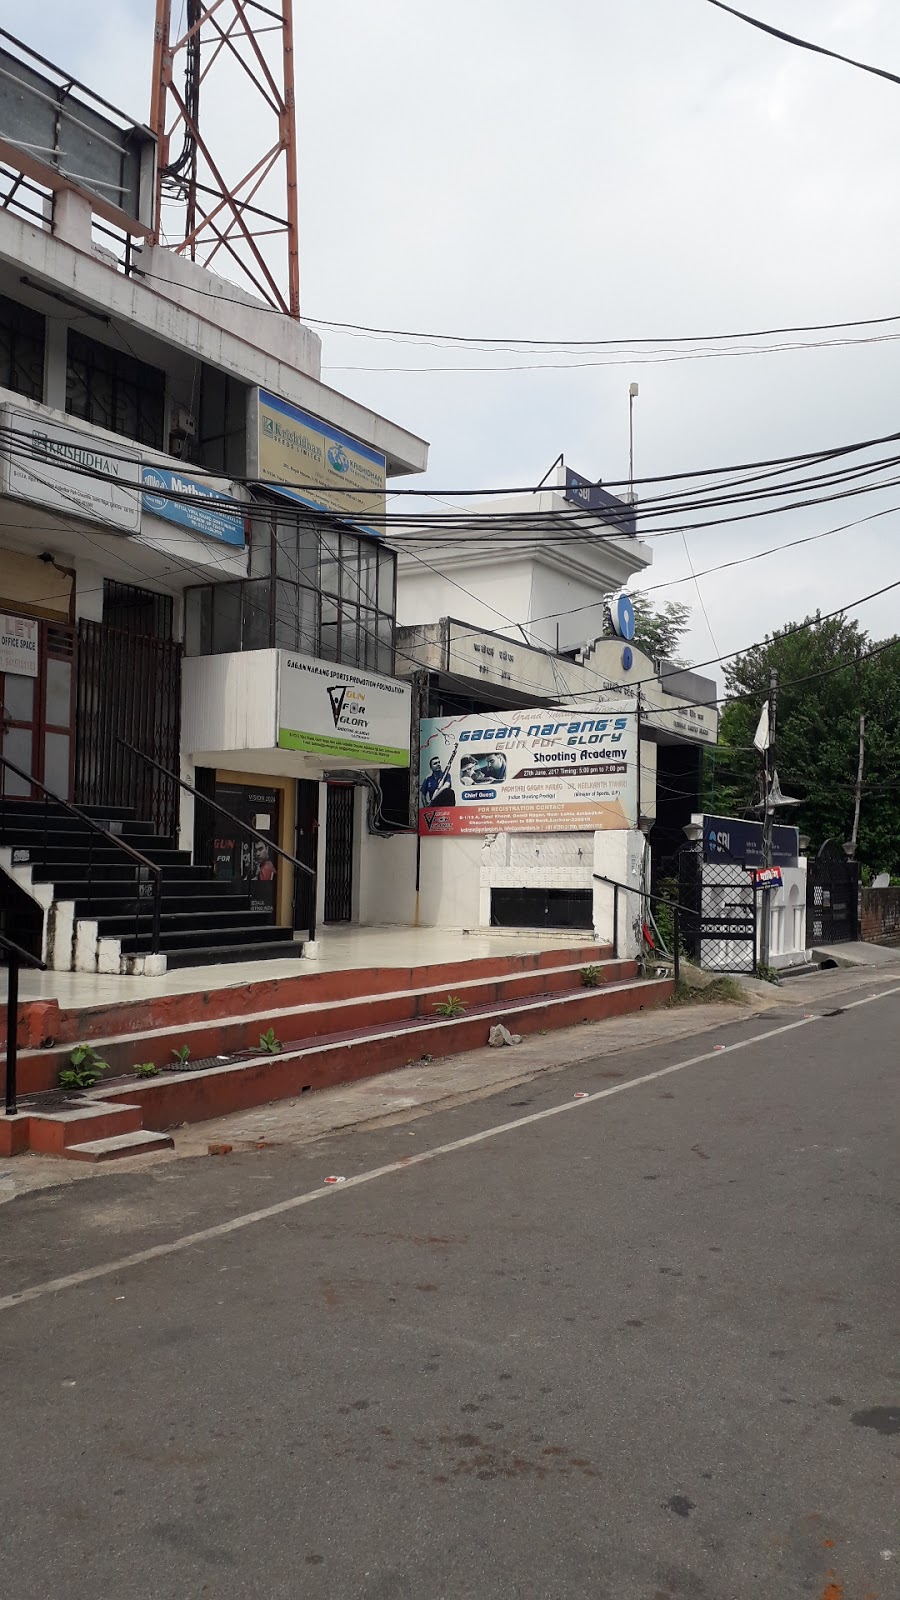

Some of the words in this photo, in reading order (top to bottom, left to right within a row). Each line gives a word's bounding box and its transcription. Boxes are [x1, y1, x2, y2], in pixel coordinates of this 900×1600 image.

[274, 436, 294, 450] SEEDS
[275, 422, 321, 455] Krishidhan
[48, 441, 119, 476] KRISHIDHAN
[349, 459, 382, 483] KRISHIDHAN
[579, 482, 591, 502] SBI
[5, 616, 34, 639] LET
[2, 636, 19, 649] OFFICE
[20, 640, 35, 652] SPACE
[307, 664, 329, 677] NARANG
[330, 670, 349, 682] SPORTS
[349, 675, 376, 688] PROMOTION
[377, 682, 404, 694] FOUNDATION
[346, 690, 365, 701] GUN
[342, 702, 365, 714] FOR
[340, 715, 370, 728] GLORY
[512, 710, 543, 724] Grand
[534, 752, 576, 762] Shooting
[580, 748, 627, 760] Academy
[560, 767, 578, 775] Timing:
[214, 839, 235, 849] GUN
[717, 831, 730, 853] SBI
